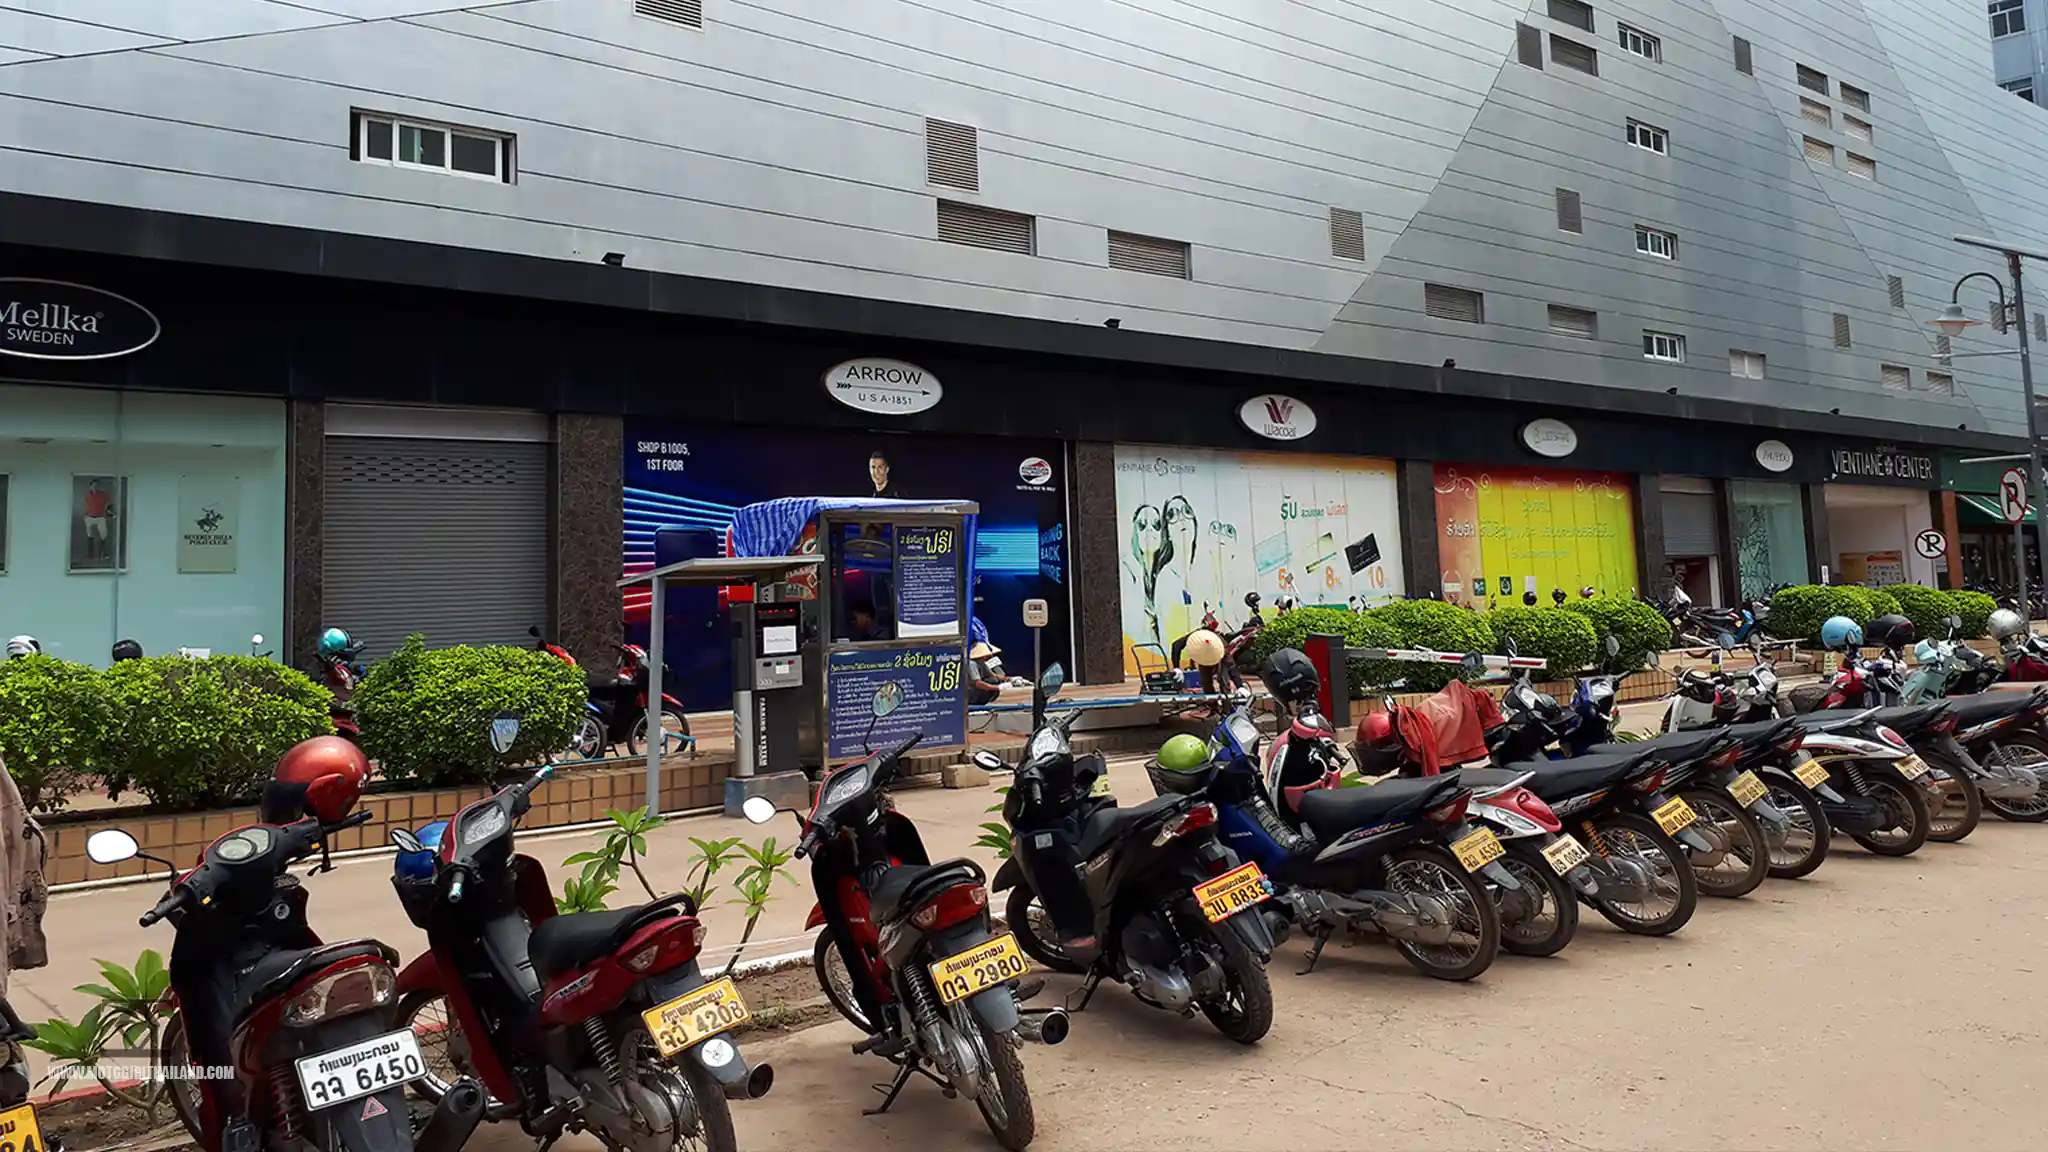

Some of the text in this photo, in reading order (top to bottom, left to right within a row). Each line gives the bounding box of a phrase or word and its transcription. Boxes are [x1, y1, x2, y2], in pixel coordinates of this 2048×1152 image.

[0, 302, 98, 333] Mellka
[7, 328, 74, 345] SWEDEN
[846, 366, 922, 385] ARROW
[1264, 424, 1297, 438] Wacoal
[637, 441, 660, 453] SHOP
[646, 459, 684, 471] 1ST FOOR
[1831, 450, 1932, 480] VIENTIANE CENTER
[2005, 482, 2018, 515] P
[974, 954, 1022, 987] 2980
[696, 1000, 744, 1032] 4208
[356, 1054, 419, 1090] 6450
